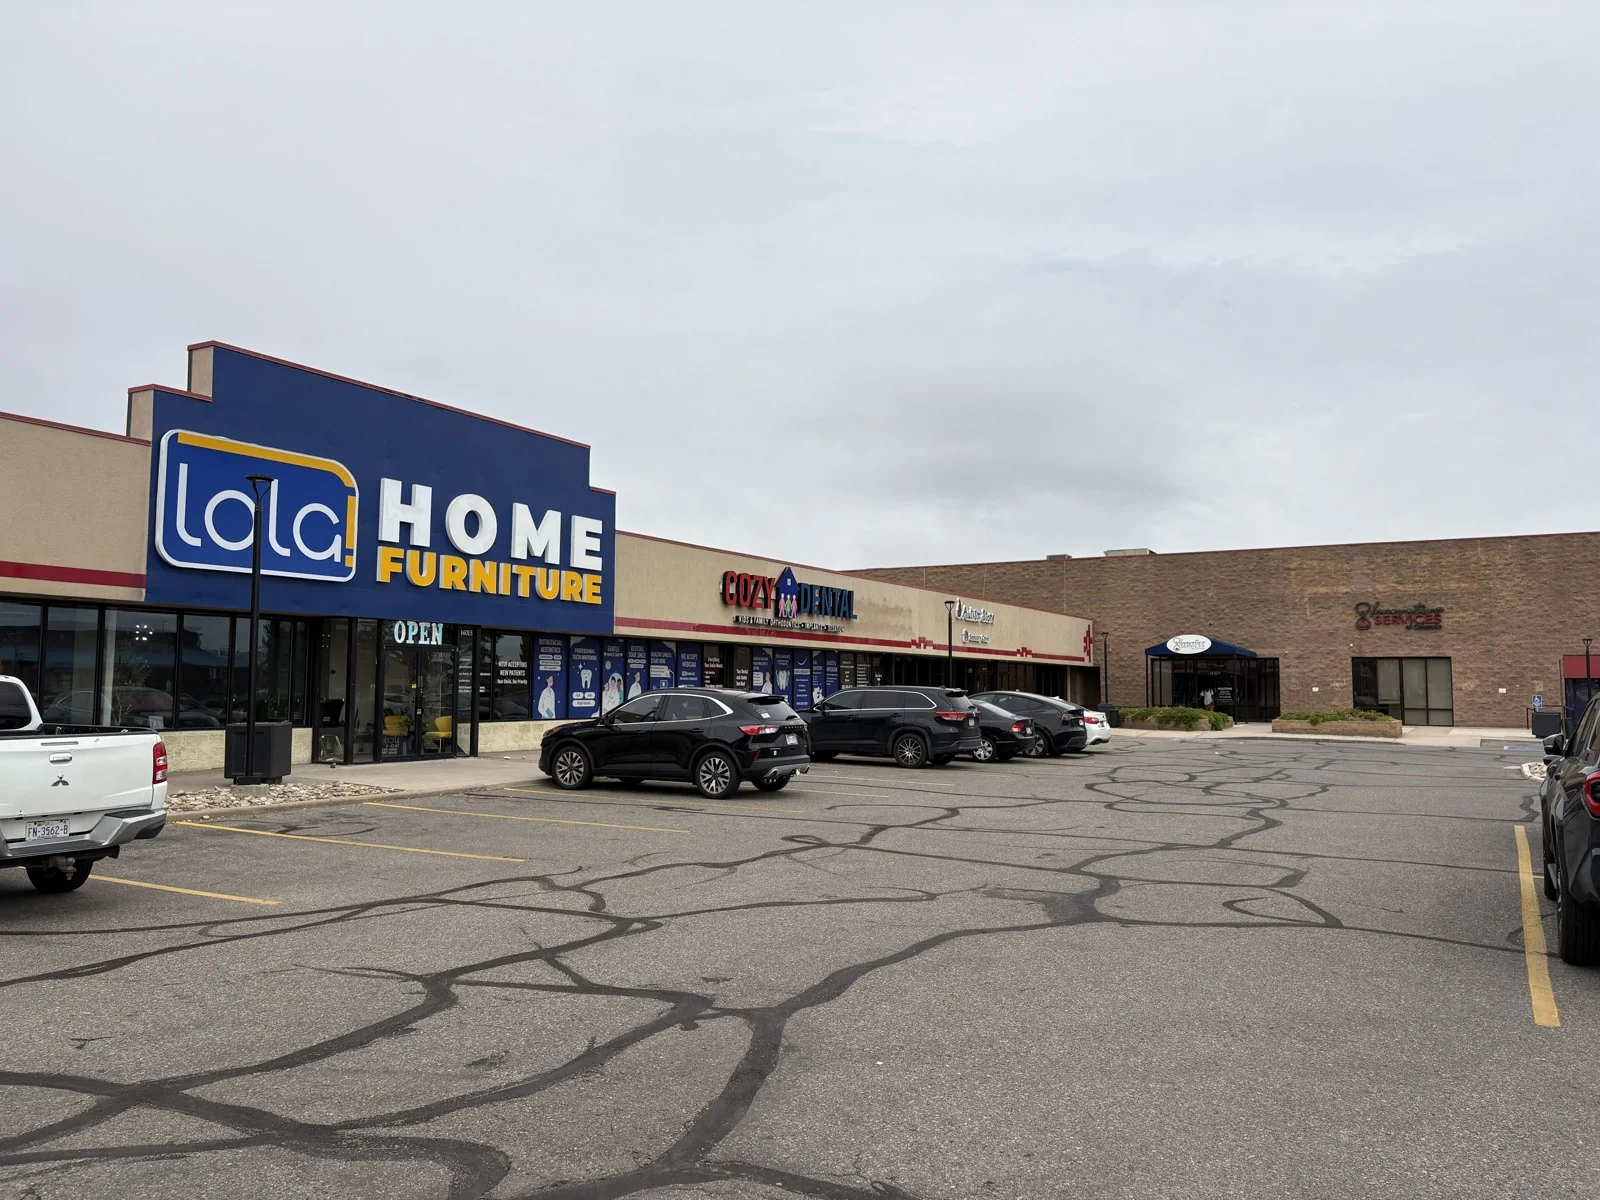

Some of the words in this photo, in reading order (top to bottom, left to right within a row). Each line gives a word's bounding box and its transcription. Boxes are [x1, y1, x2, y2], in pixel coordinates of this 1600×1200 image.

[378, 477, 603, 572] HOME
[376, 545, 602, 605] FURNITURE
[723, 570, 776, 609] COZY
[798, 582, 857, 620] DENTAL
[393, 620, 444, 646] OPEN
[738, 616, 749, 625] KIDS
[753, 617, 769, 627] FAMILY
[770, 618, 800, 630] ORTHODONTICS
[1374, 614, 1442, 626] SERVICES
[27, 824, 69, 838] FN-3562-B
